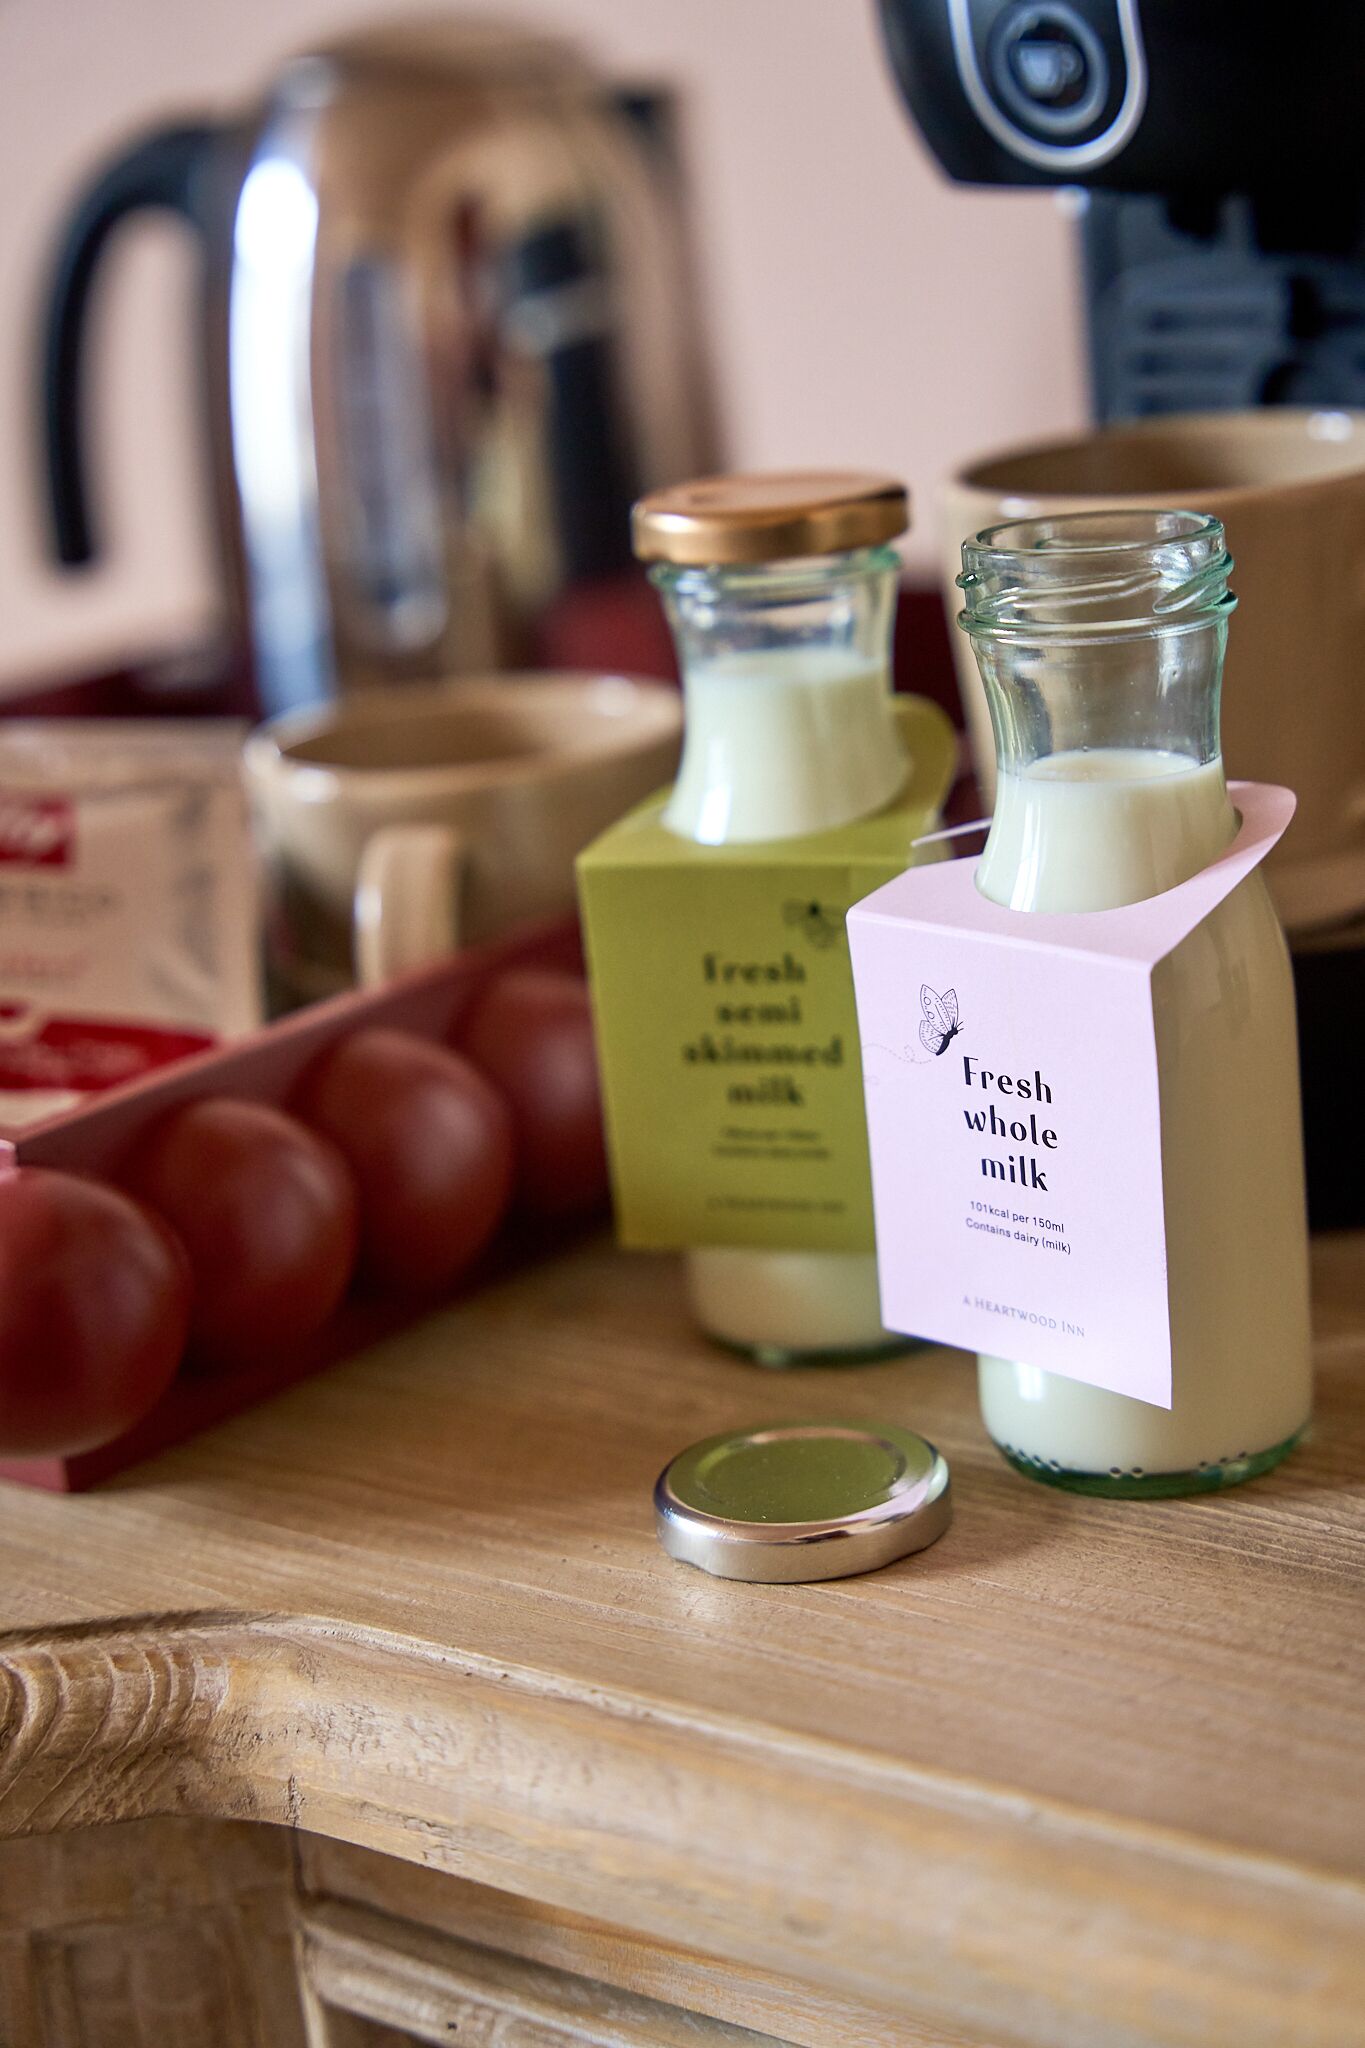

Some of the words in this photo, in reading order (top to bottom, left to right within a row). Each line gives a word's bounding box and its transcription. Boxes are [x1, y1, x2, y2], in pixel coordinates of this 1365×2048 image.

[963, 1055, 1053, 1104] Fresh
[963, 1104, 1058, 1149] whole
[980, 1155, 1049, 1192] milk
[965, 1217, 1011, 1238] Contains
[1013, 1230, 1039, 1247] dairy
[1041, 1236, 1071, 1255] (milk)
[970, 1200, 1010, 1219] 101kcal
[1012, 1212, 1029, 1224] per
[1033, 1216, 1065, 1233] 150ml
[962, 1295, 971, 1305] A
[974, 1296, 1057, 1330] HEARTWOOD
[1061, 1320, 1086, 1338] INN
